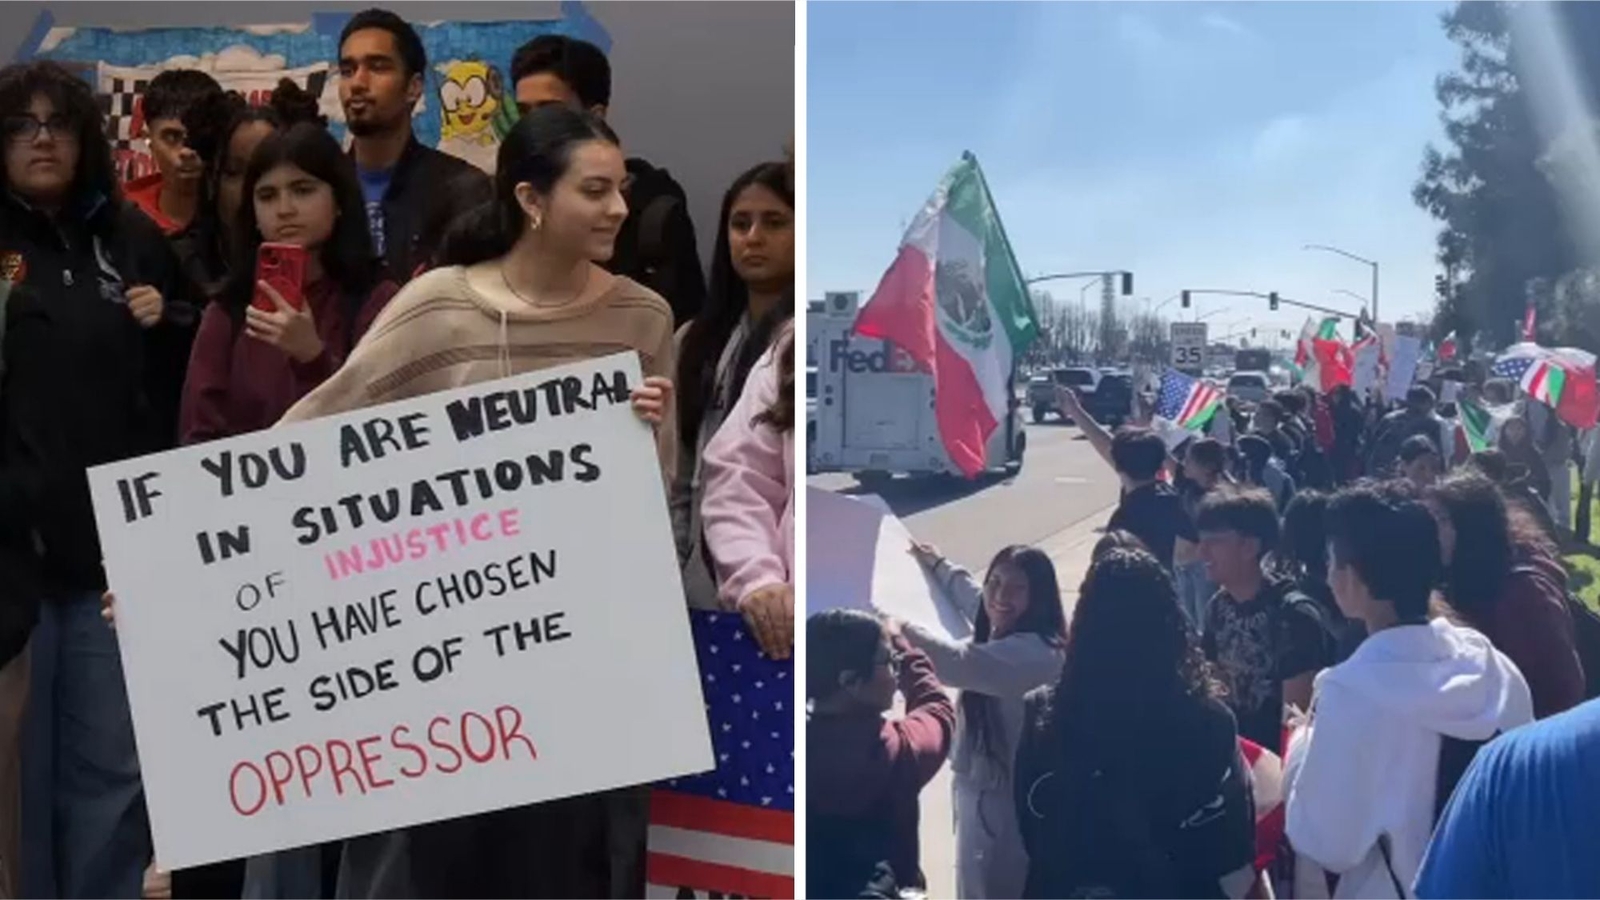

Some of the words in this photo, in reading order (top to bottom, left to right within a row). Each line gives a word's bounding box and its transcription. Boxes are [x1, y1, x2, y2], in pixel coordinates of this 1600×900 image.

[1175, 347, 1201, 363] 35
[116, 472, 162, 523] IF
[200, 442, 306, 497] YOU
[340, 412, 430, 468] ARE
[445, 370, 633, 442] NEUTRAL
[196, 525, 250, 565] IN
[291, 443, 601, 545] SITUATIONS
[219, 619, 299, 680] YOU
[311, 589, 402, 650] HAVE
[415, 549, 557, 616] CHOSEN
[236, 572, 286, 611] OF
[324, 509, 520, 580] INJUSTICE
[196, 687, 291, 737] THE
[309, 659, 399, 711] SIDE
[412, 637, 463, 683] OF
[483, 612, 572, 657] THE
[229, 705, 537, 816] OPPRESSOR
